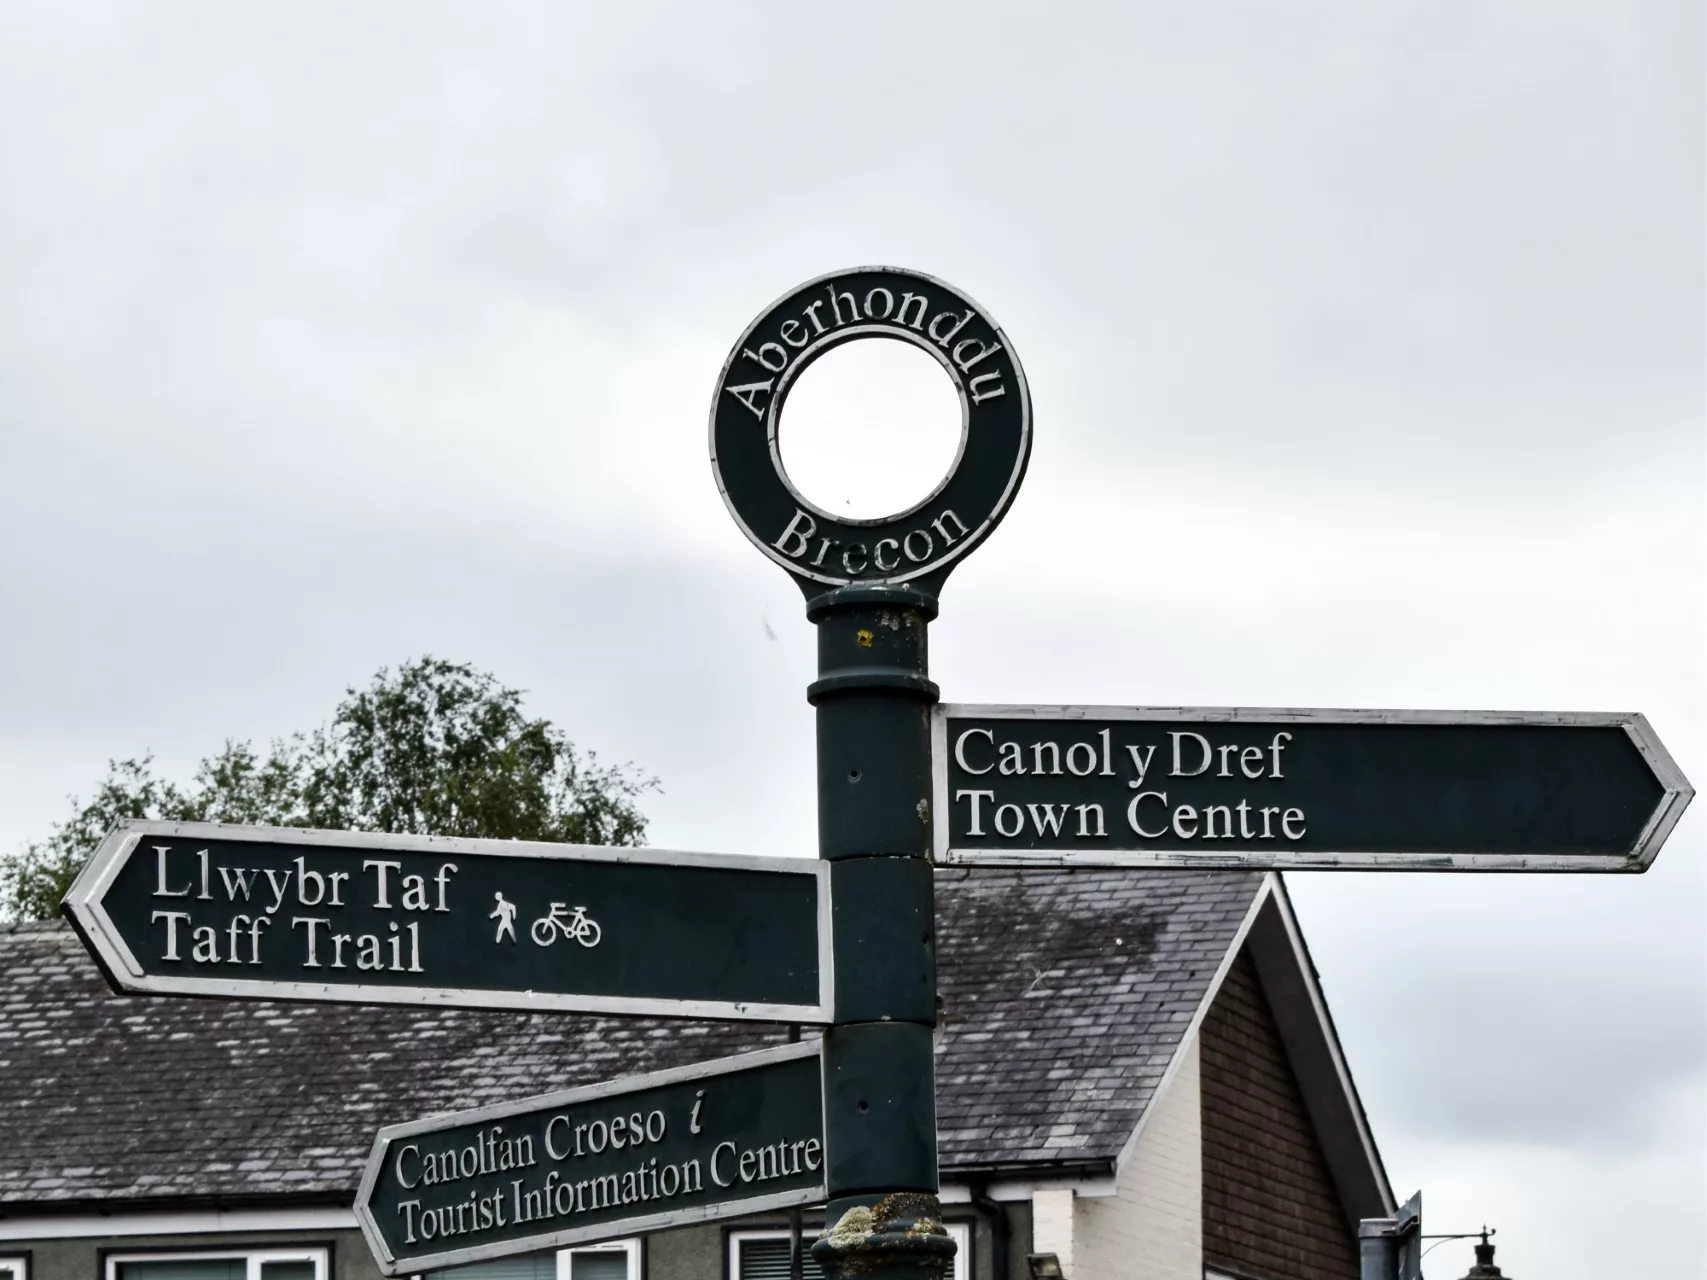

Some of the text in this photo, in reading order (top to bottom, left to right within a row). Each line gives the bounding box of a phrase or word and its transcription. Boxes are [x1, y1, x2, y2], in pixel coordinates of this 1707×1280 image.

[725, 283, 1006, 422] Aberhonddu
[770, 508, 975, 575] Brecon
[954, 728, 1294, 789] Canol y Dref
[955, 789, 1307, 840] Town Centre
[152, 845, 460, 914] Llwybr Taf
[151, 910, 425, 973] Taff Trail
[395, 1126, 537, 1189] Canolfan
[544, 1111, 667, 1161] Croeso
[397, 1138, 823, 1244] Tourist Information Centre
